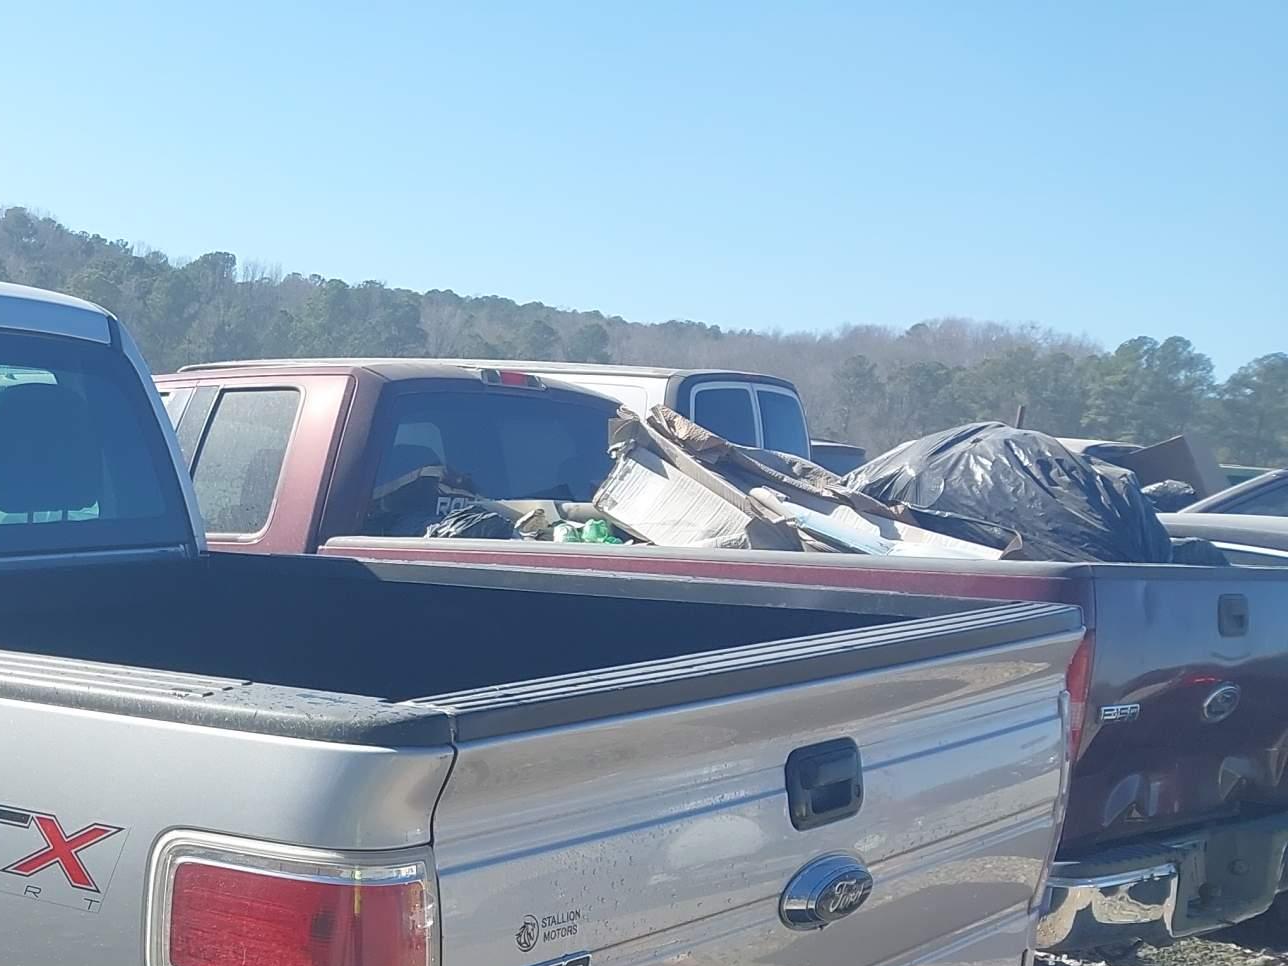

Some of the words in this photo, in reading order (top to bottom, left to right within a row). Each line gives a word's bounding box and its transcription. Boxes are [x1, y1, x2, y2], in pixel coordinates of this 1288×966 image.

[829, 879, 865, 913] Ford
[541, 909, 581, 929] STALLION
[543, 924, 578, 943] MOTORS
